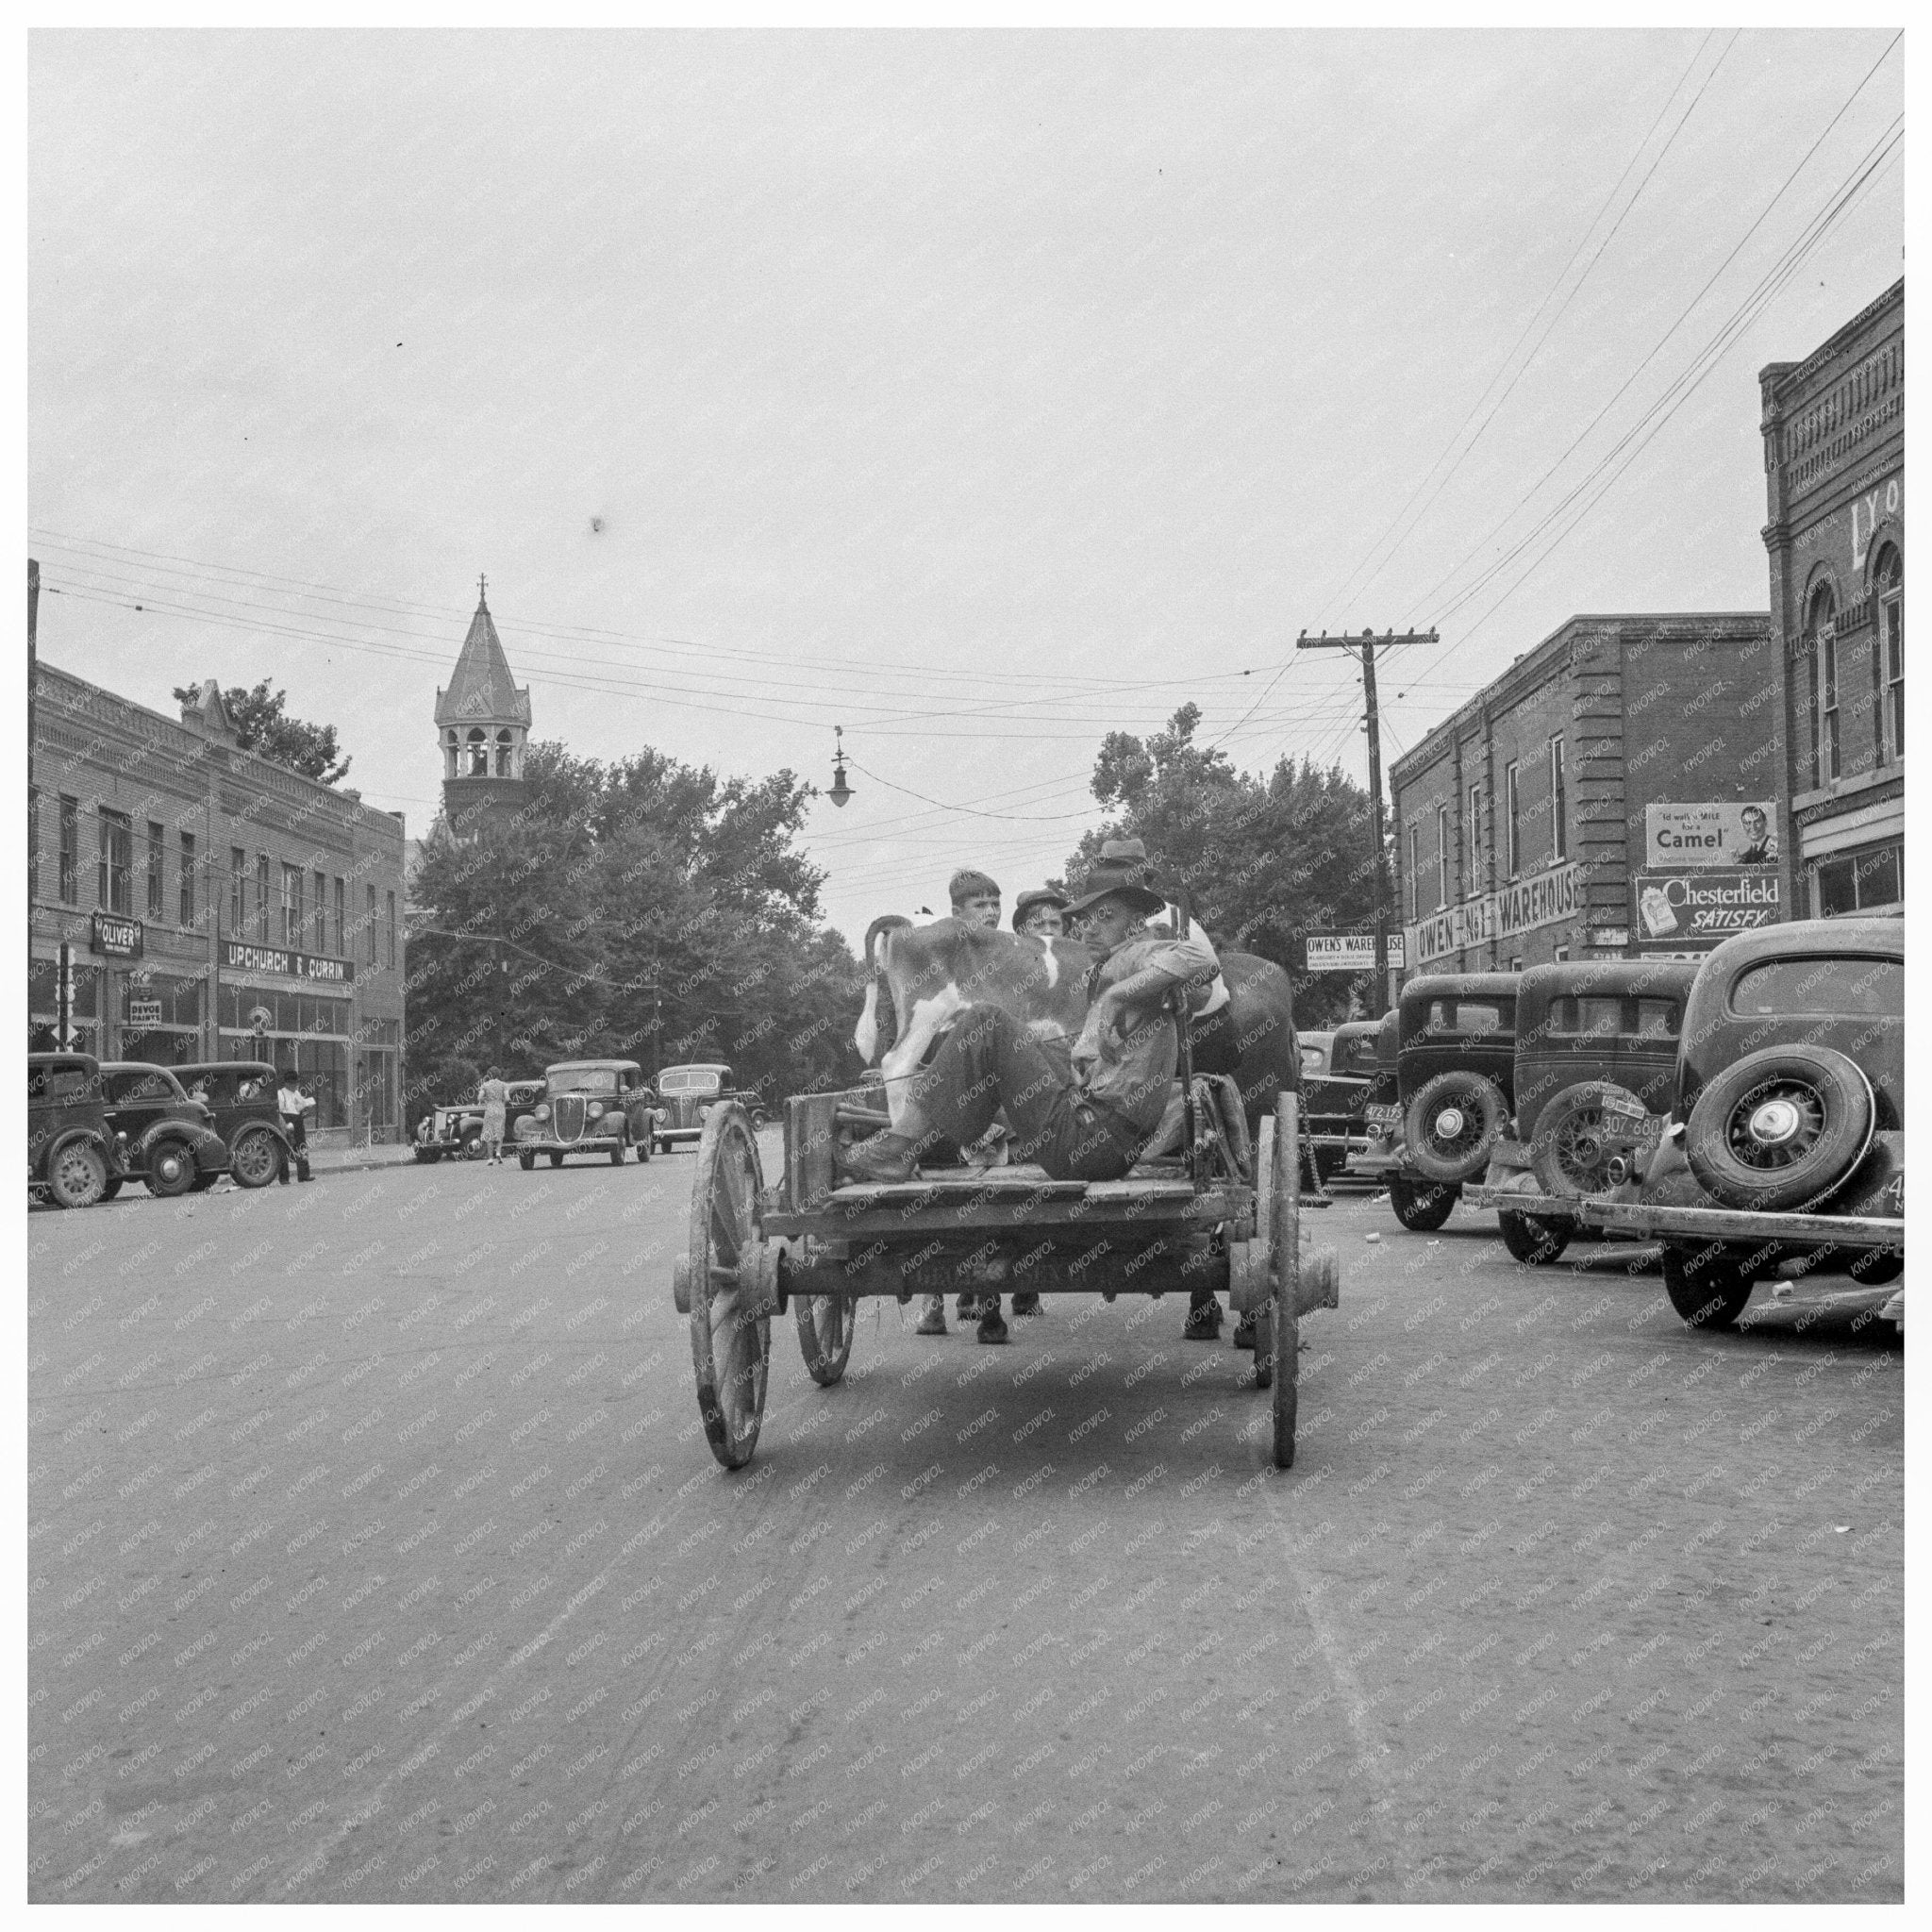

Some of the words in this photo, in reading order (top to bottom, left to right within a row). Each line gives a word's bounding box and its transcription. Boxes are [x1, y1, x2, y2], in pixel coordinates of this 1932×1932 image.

[1851, 479, 1899, 572] LYO
[1701, 812, 1720, 821] MILE
[1662, 878, 1779, 908] Chesterfield
[1690, 908, 1768, 928] SATISFY
[103, 924, 135, 947] OLIVER
[1419, 915, 1454, 958] OWEN
[228, 944, 289, 973] UPCHURCH
[308, 958, 343, 980] CURRIN
